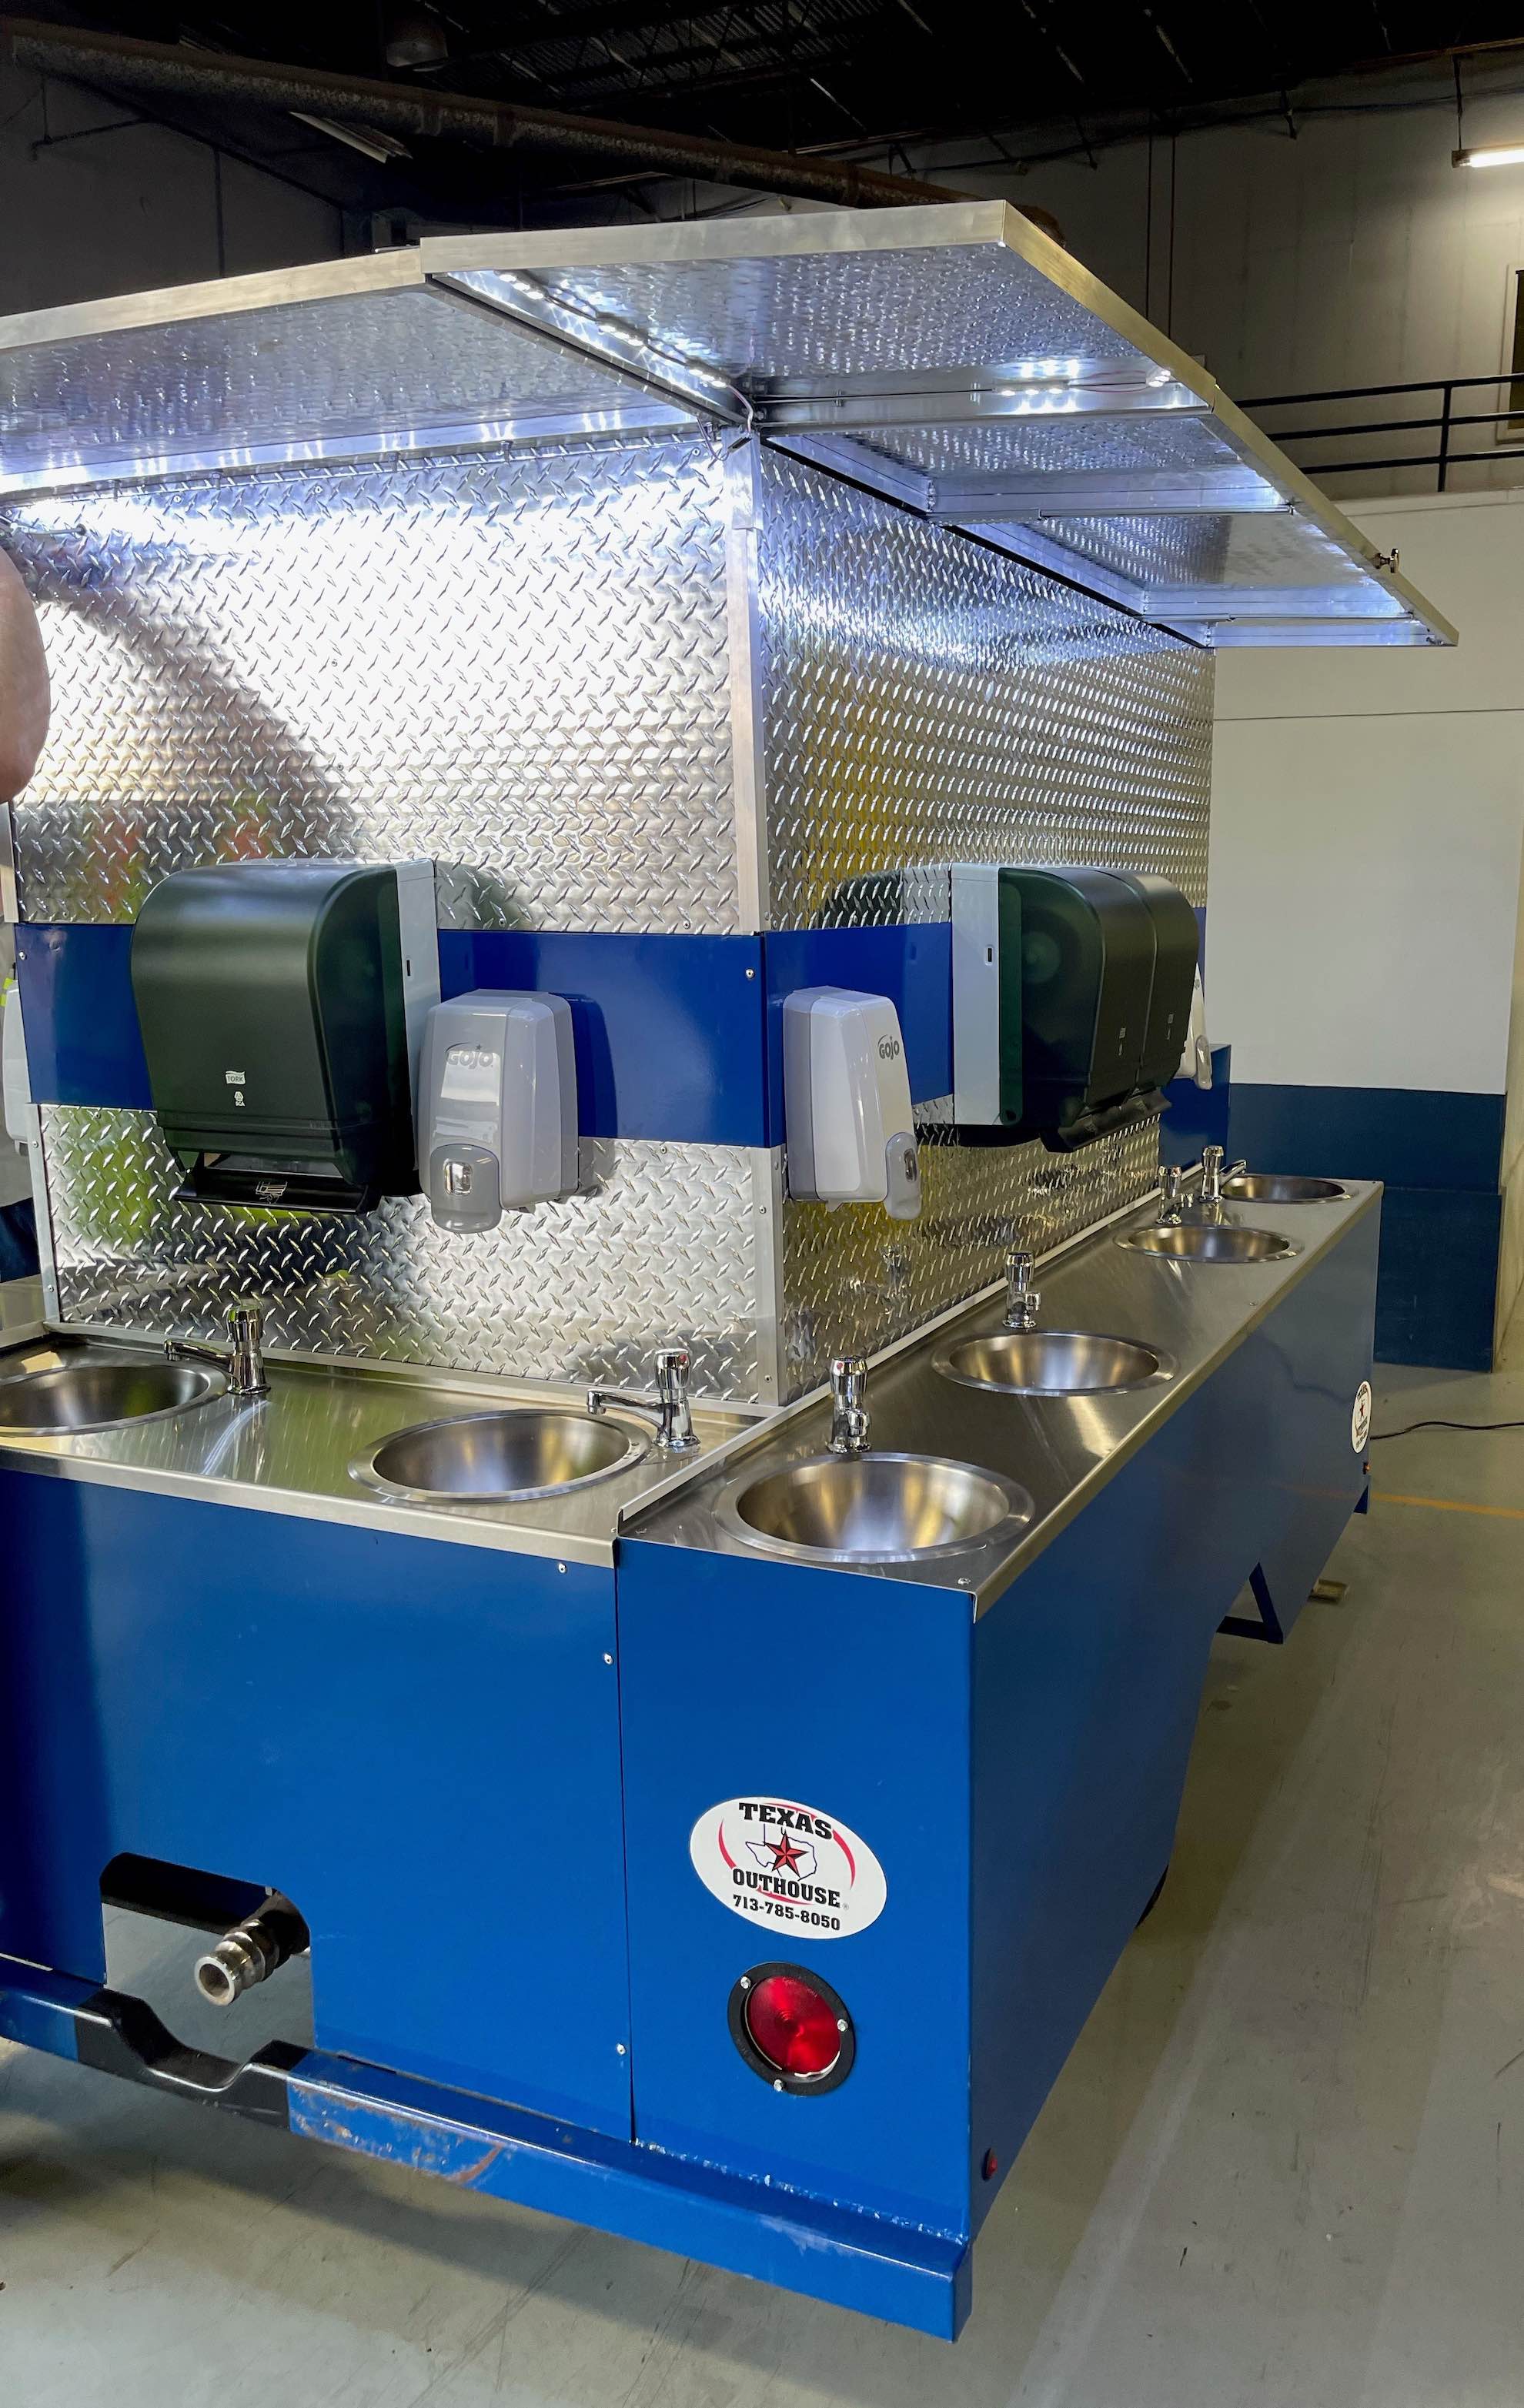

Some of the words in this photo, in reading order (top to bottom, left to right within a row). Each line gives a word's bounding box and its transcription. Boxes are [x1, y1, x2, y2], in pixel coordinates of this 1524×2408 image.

[739, 1802, 833, 1840] TEXAS
[732, 1868, 841, 1909] OUTHOUSE
[732, 1894, 841, 1931] 713-785-8050
